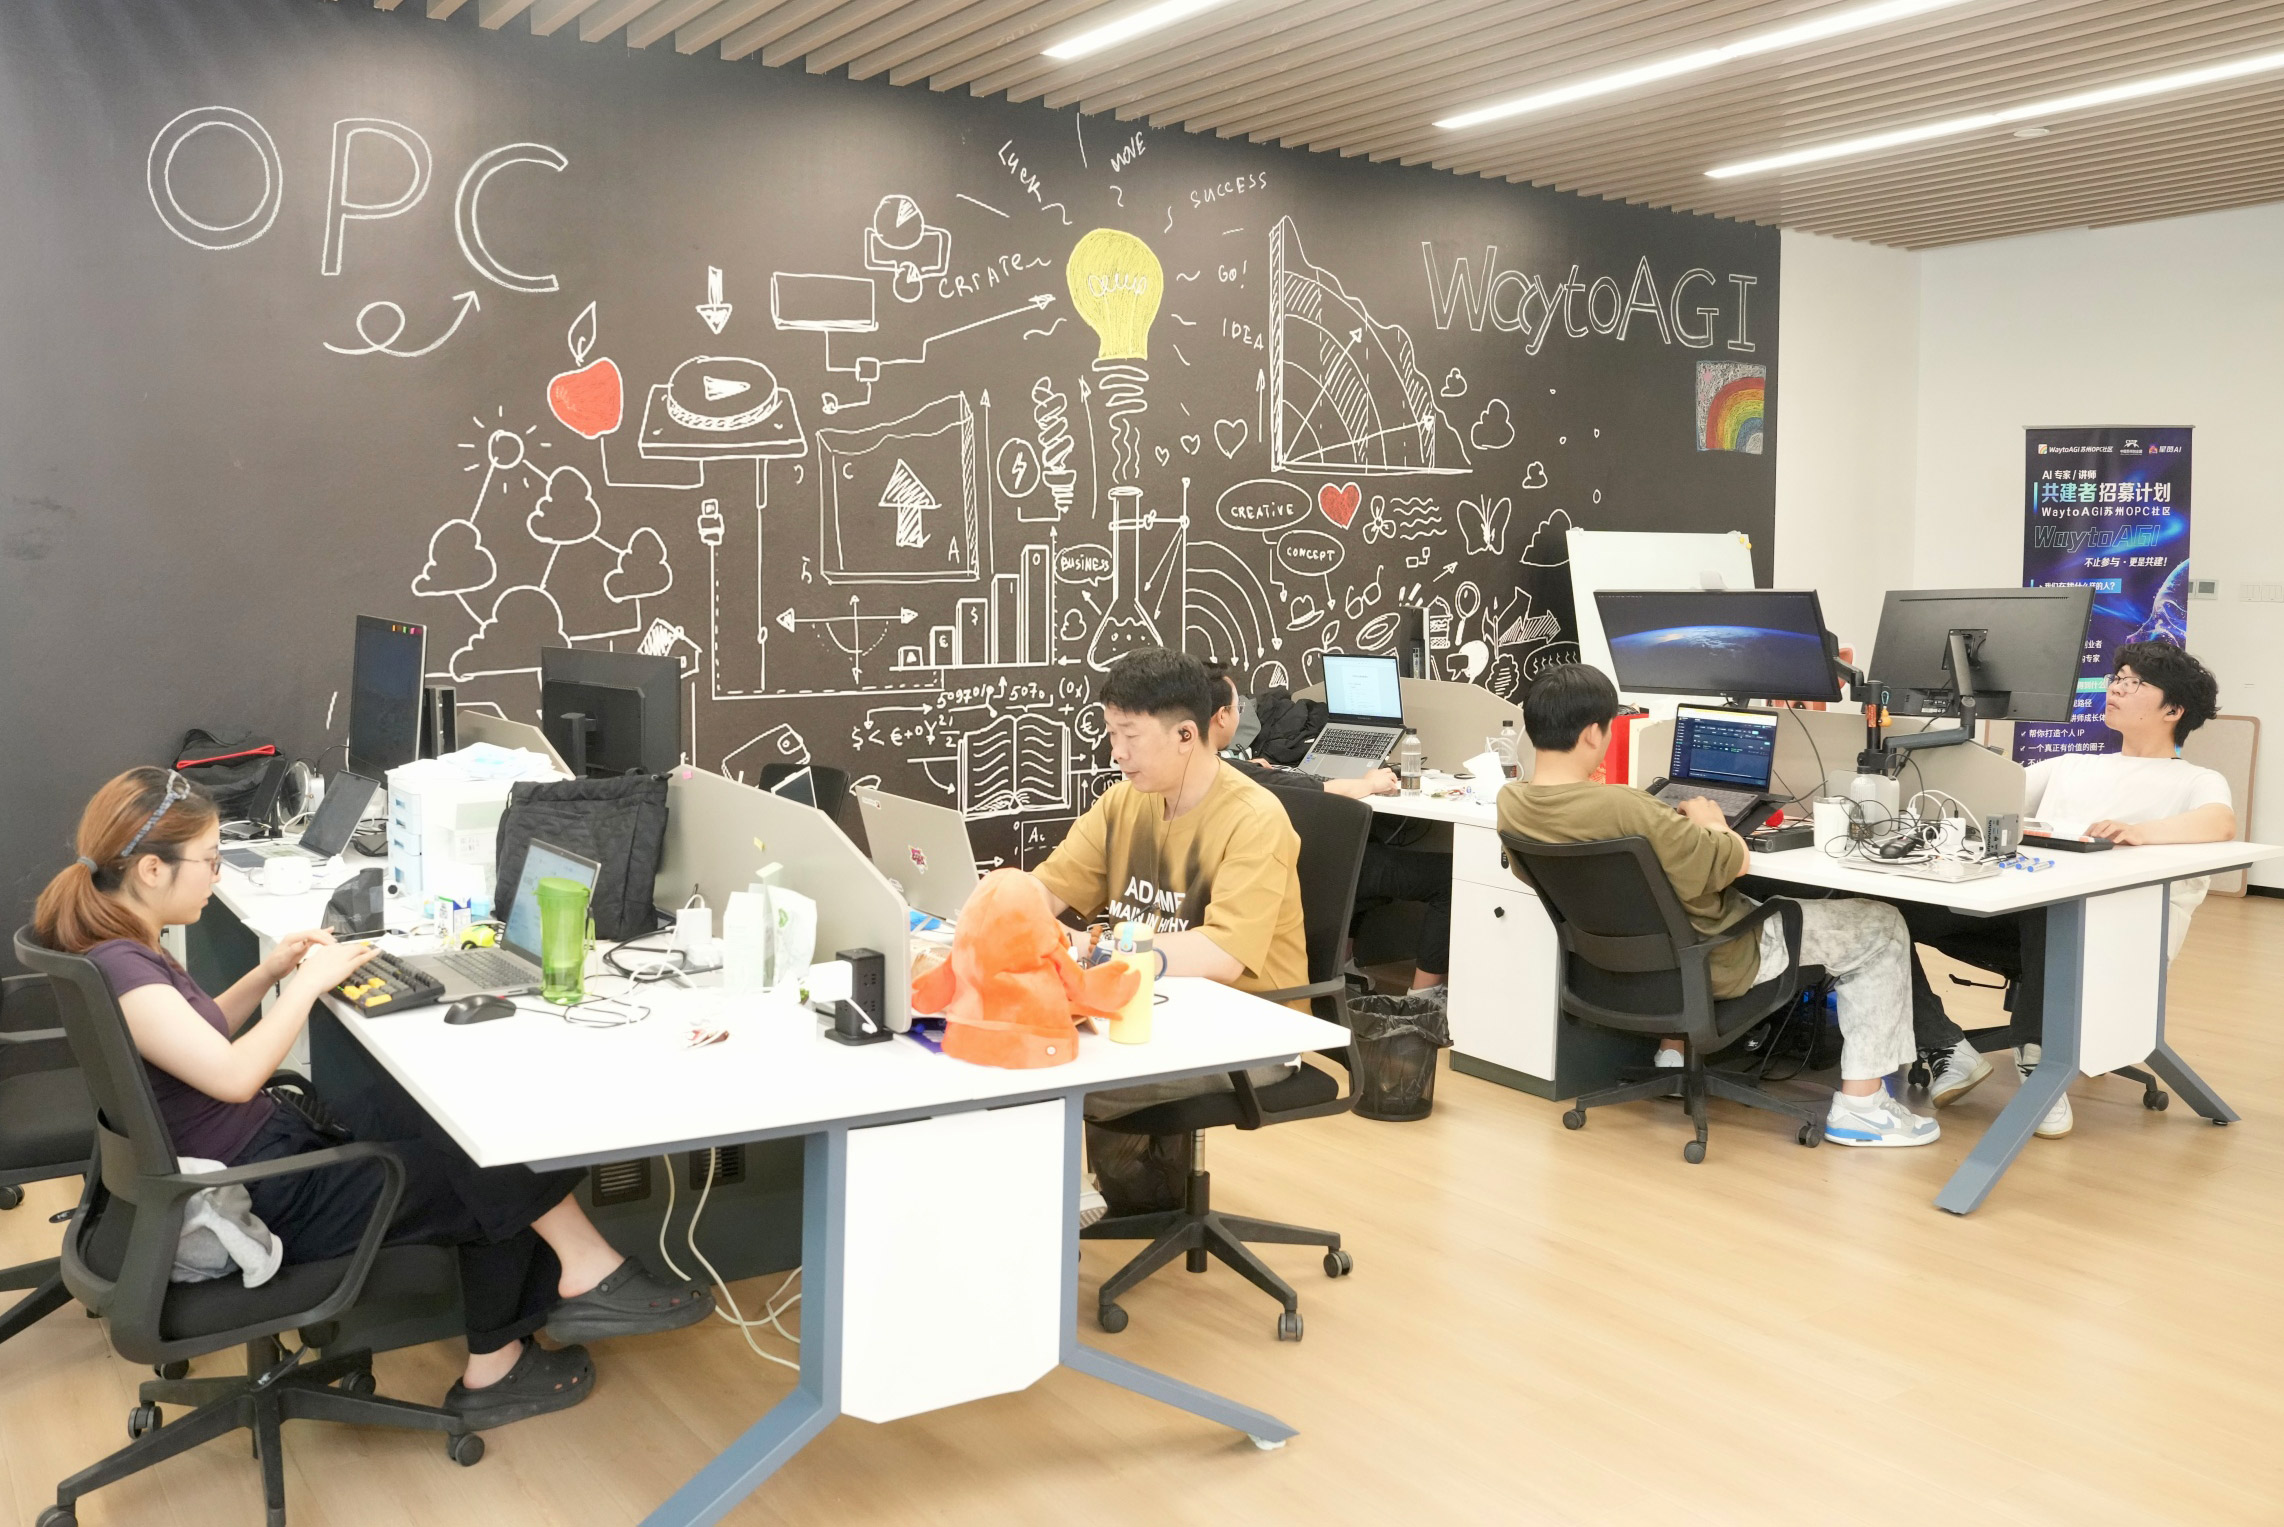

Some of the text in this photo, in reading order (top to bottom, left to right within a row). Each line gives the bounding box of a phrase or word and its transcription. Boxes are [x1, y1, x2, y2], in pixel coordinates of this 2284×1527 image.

[148, 106, 568, 292] OPC
[1190, 172, 1267, 208] SUCCESS
[1421, 242, 1758, 355] WaytoAGI
[2042, 470, 2052, 480] AI
[2054, 470, 2071, 480] 专家
[2078, 470, 2097, 480] 讲师
[2042, 482, 2171, 503] 共建者招募计划
[2034, 525, 2161, 553] WaytoAGI
